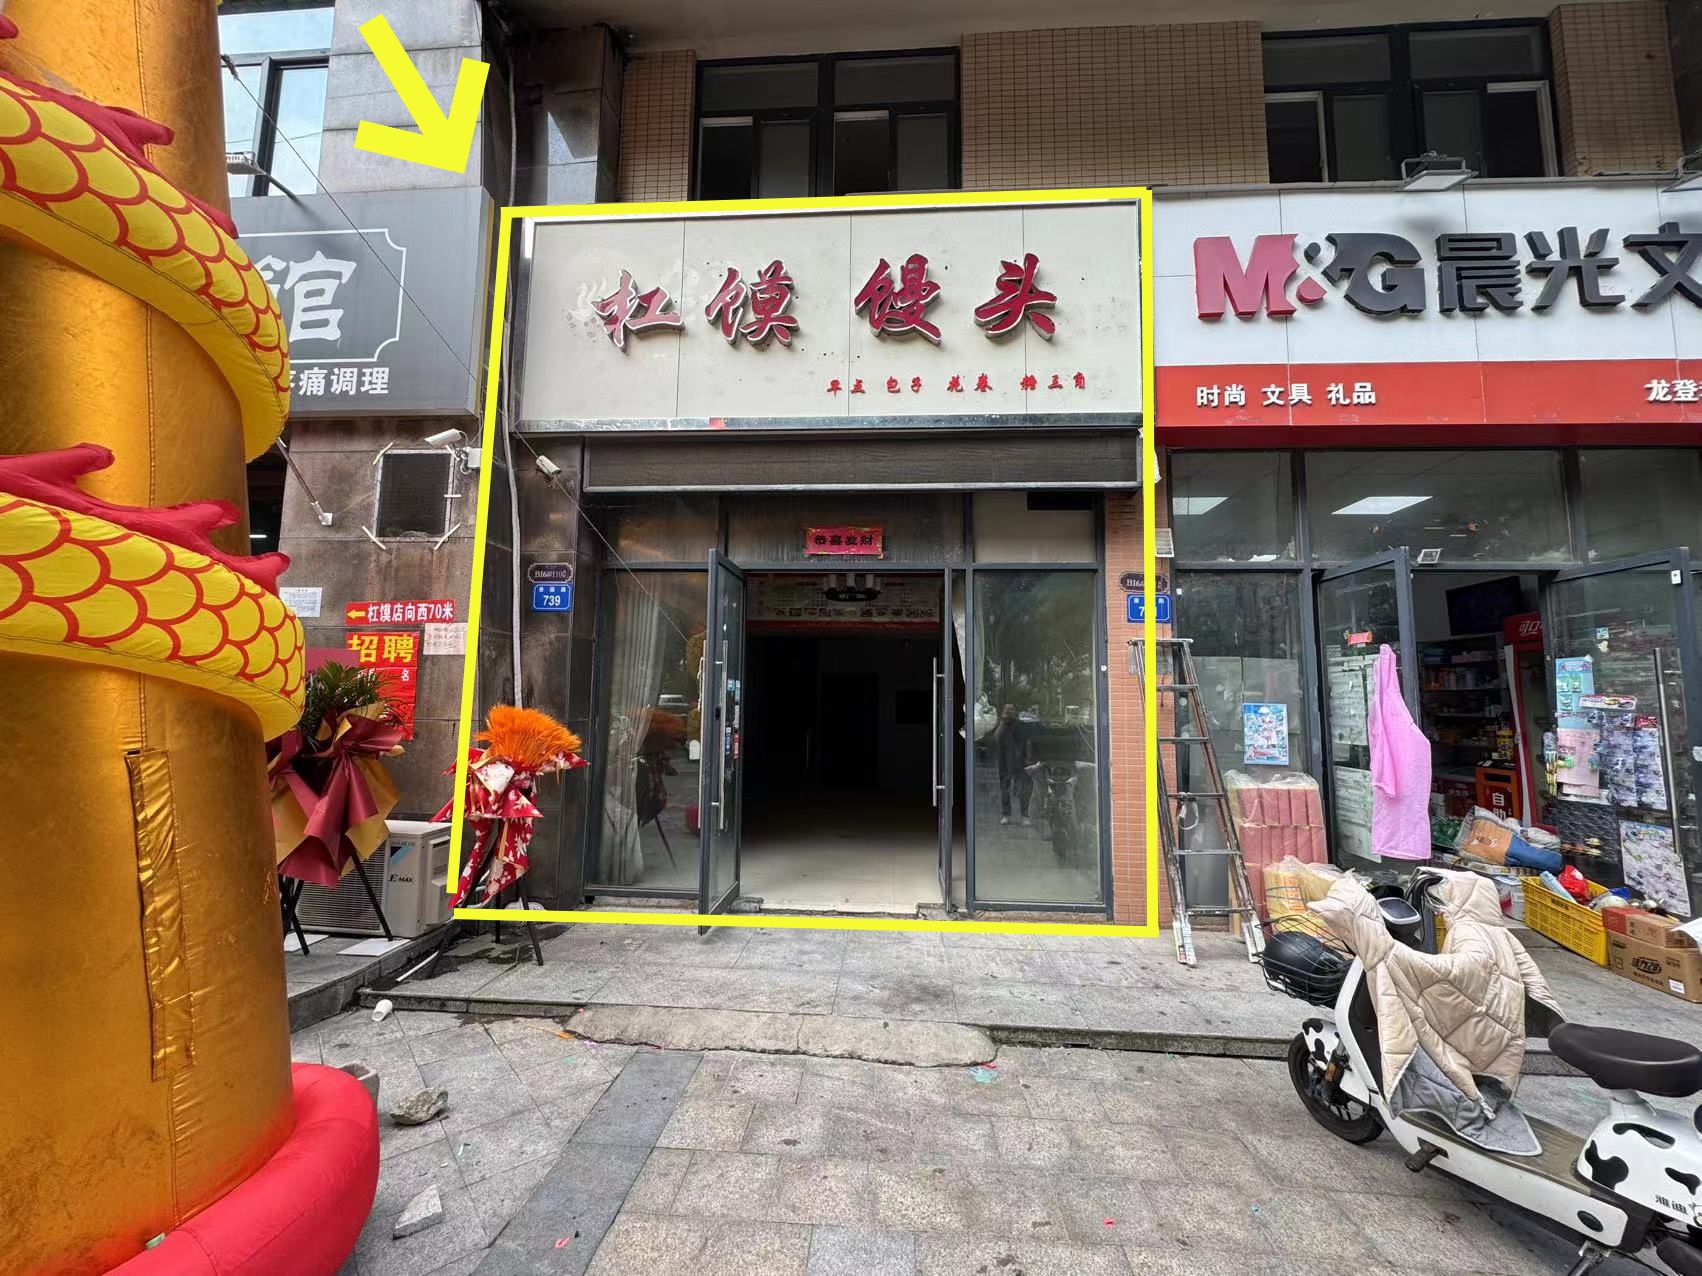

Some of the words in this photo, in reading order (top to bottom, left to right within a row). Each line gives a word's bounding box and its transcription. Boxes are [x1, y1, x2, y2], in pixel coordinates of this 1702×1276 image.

[290, 367, 390, 396] 痛调理
[826, 378, 866, 396] 早点
[885, 376, 923, 394] 包子
[946, 373, 993, 393] 花卷
[1019, 371, 1087, 391] 糖三角
[1644, 379, 1702, 402] 龙登
[1196, 384, 1246, 408] 时尚
[1262, 383, 1313, 407] 文具
[1327, 382, 1377, 406] 礼品
[814, 534, 874, 546] 恭喜发财
[367, 601, 454, 623] 杠馍店向西70米
[543, 595, 561, 606] 739
[347, 634, 415, 663] 招聘
[401, 669, 410, 682] 名
